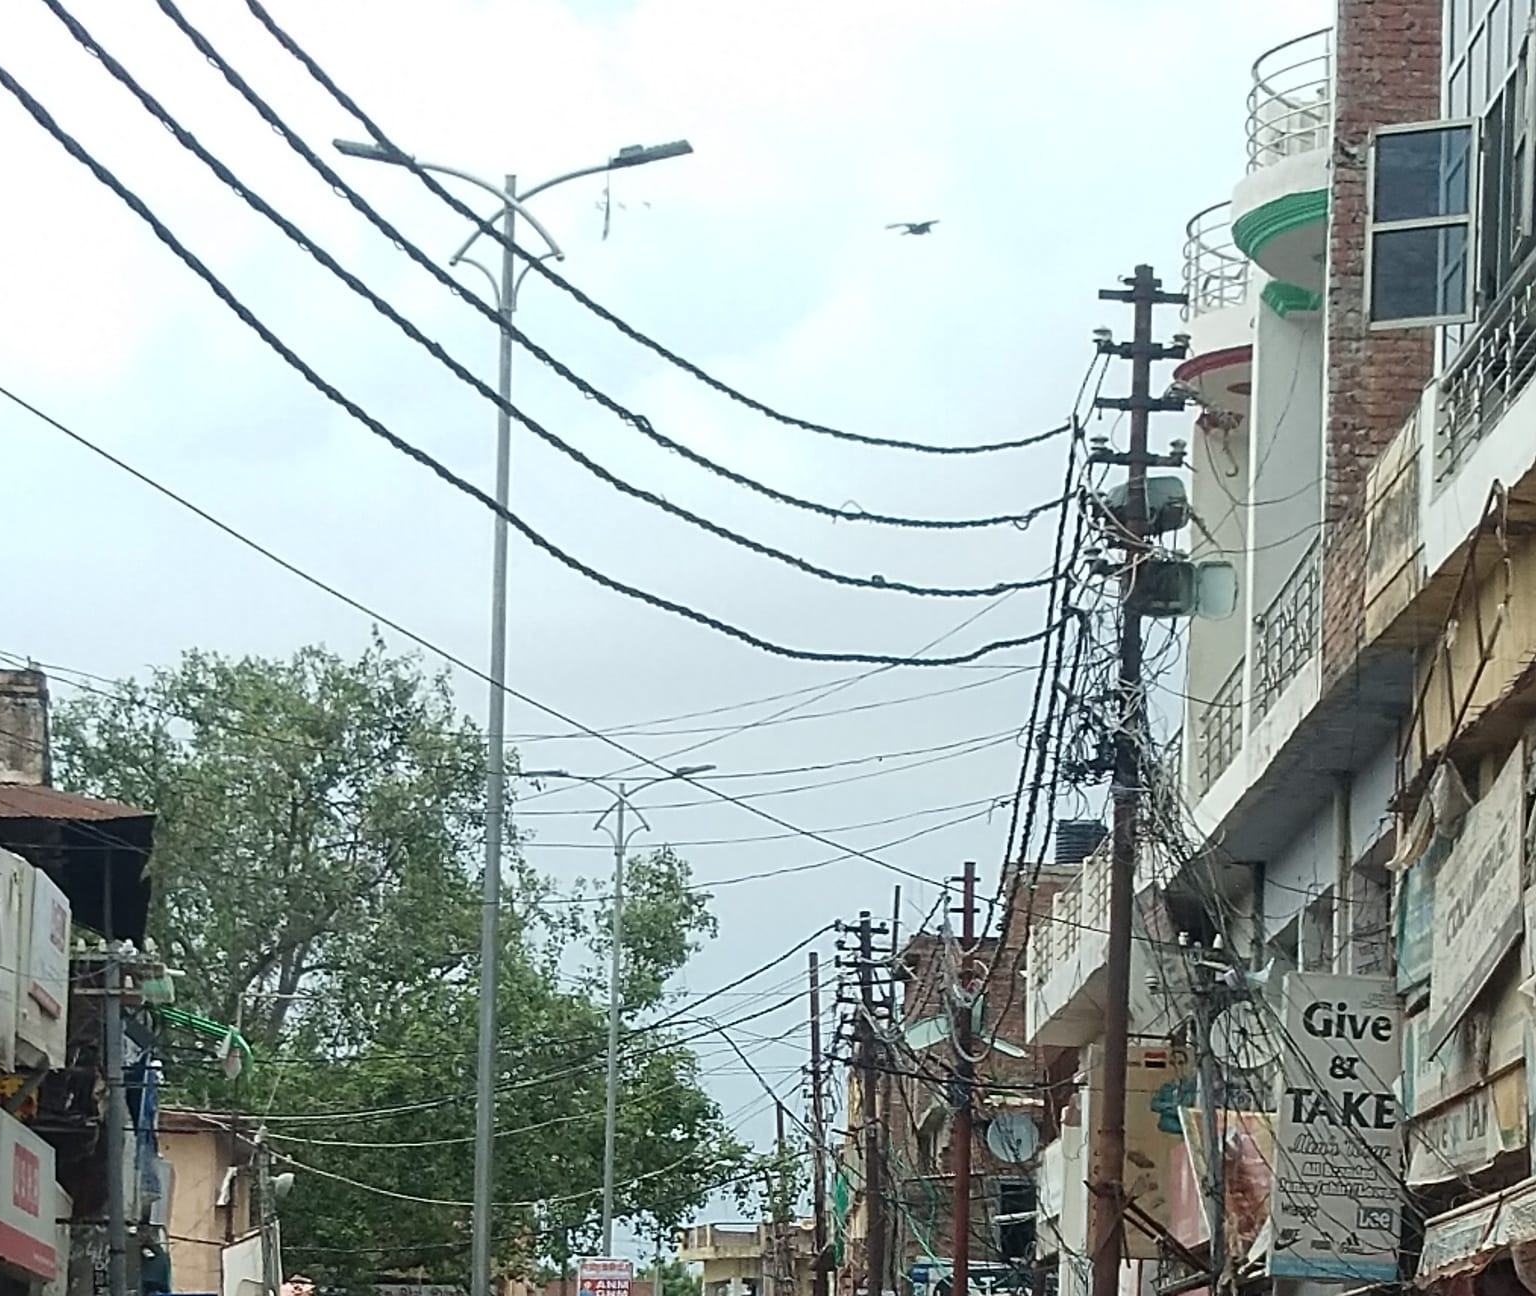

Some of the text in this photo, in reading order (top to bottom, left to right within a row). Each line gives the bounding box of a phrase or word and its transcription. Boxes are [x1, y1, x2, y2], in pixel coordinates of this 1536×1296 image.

[1303, 1001, 1392, 1042] Give
[1329, 1055, 1359, 1080] &
[1285, 1086, 1396, 1129] TAKE
[1359, 1208, 1392, 1228] Lee
[595, 1280, 629, 1289] ANM
